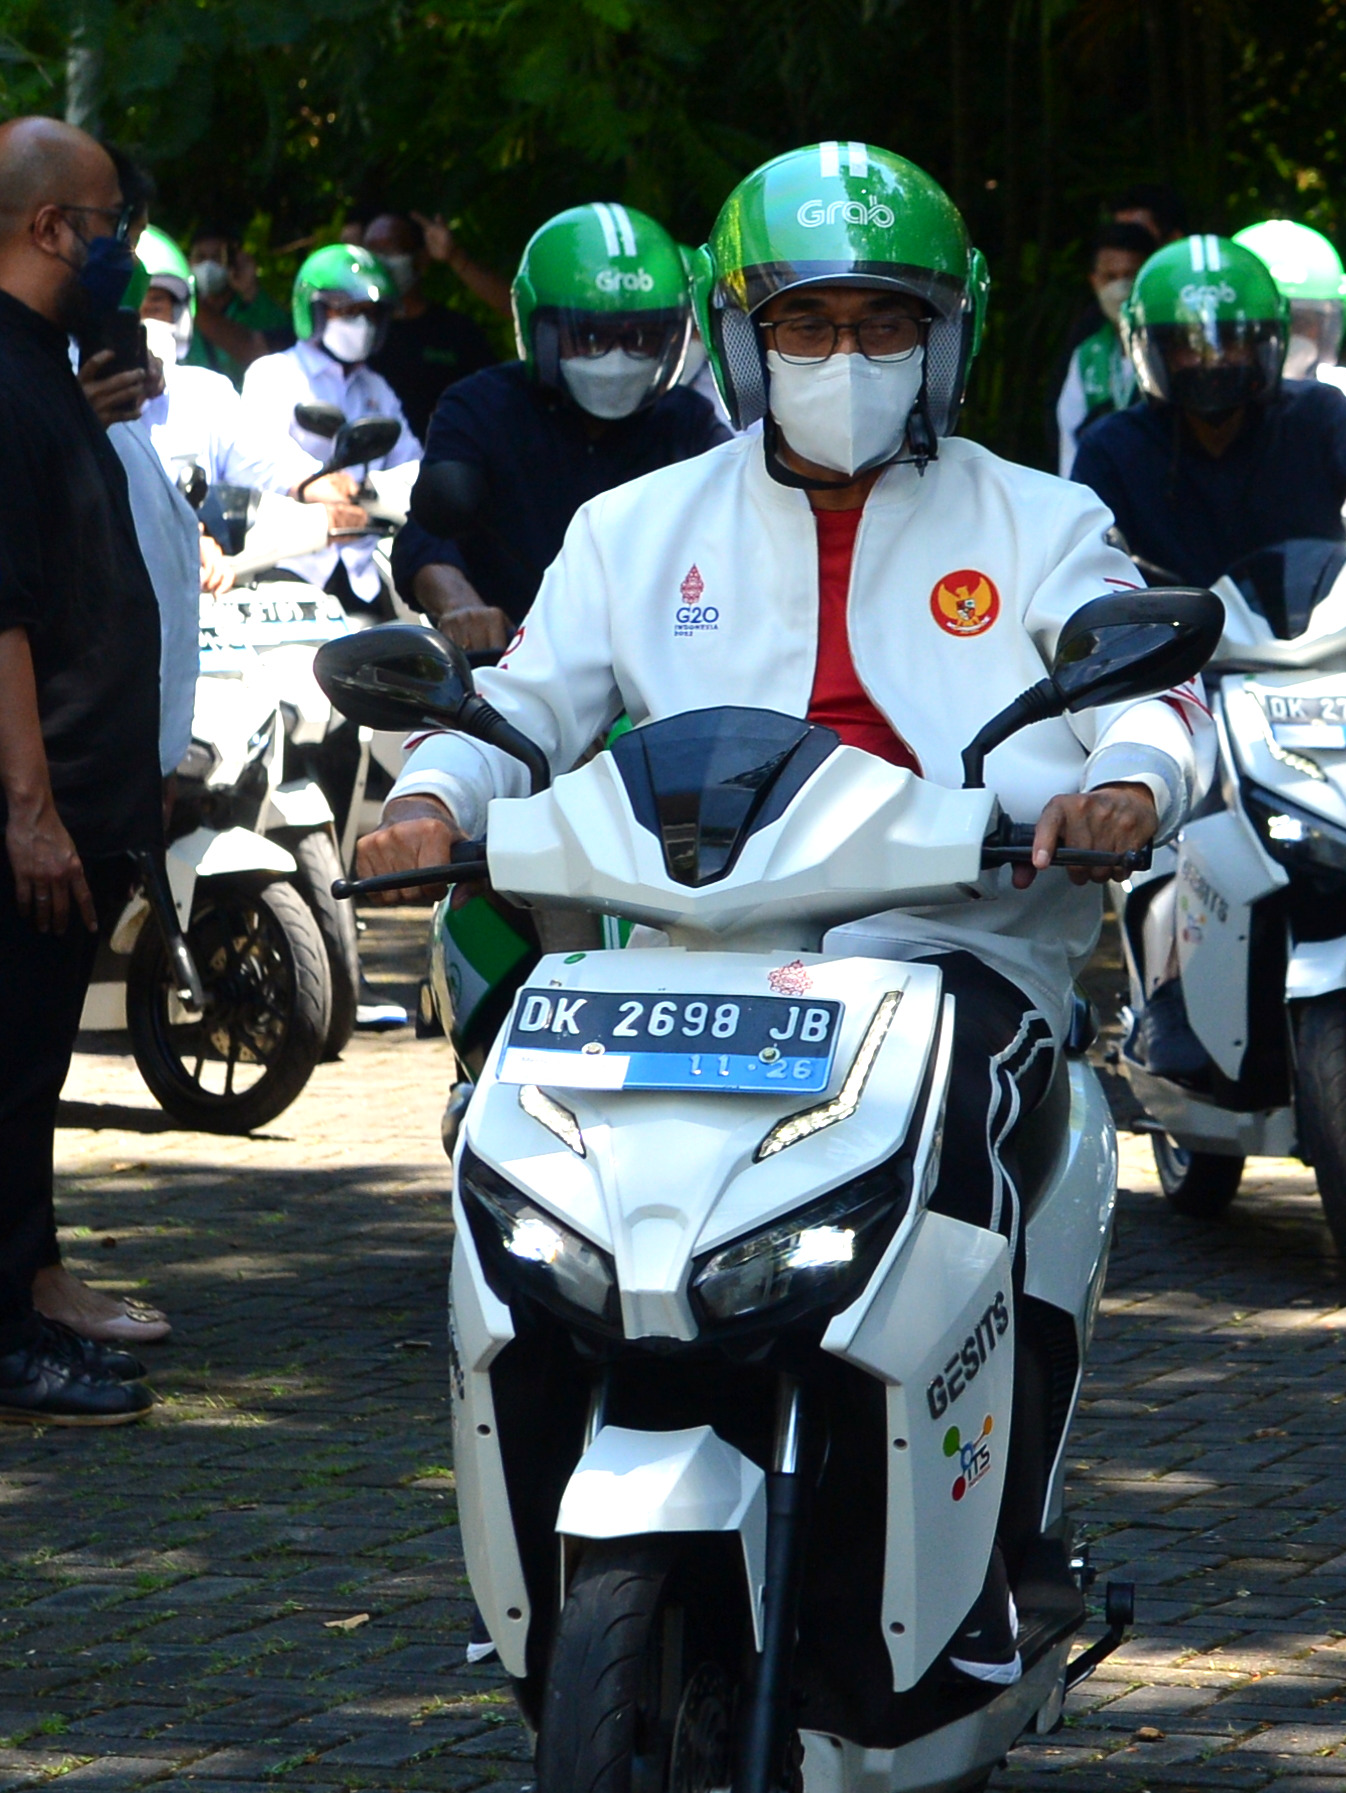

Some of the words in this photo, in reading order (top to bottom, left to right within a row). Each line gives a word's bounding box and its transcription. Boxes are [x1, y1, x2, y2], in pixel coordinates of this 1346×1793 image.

[796, 194, 895, 229] Grab
[594, 267, 654, 293] Grab
[1180, 280, 1237, 304] Grab
[676, 606, 719, 624] G20
[1270, 697, 1305, 718] DK
[518, 996, 588, 1034] DK
[612, 1001, 740, 1038] 2698
[769, 1006, 830, 1042] JB
[926, 1290, 1009, 1420] GESITS
